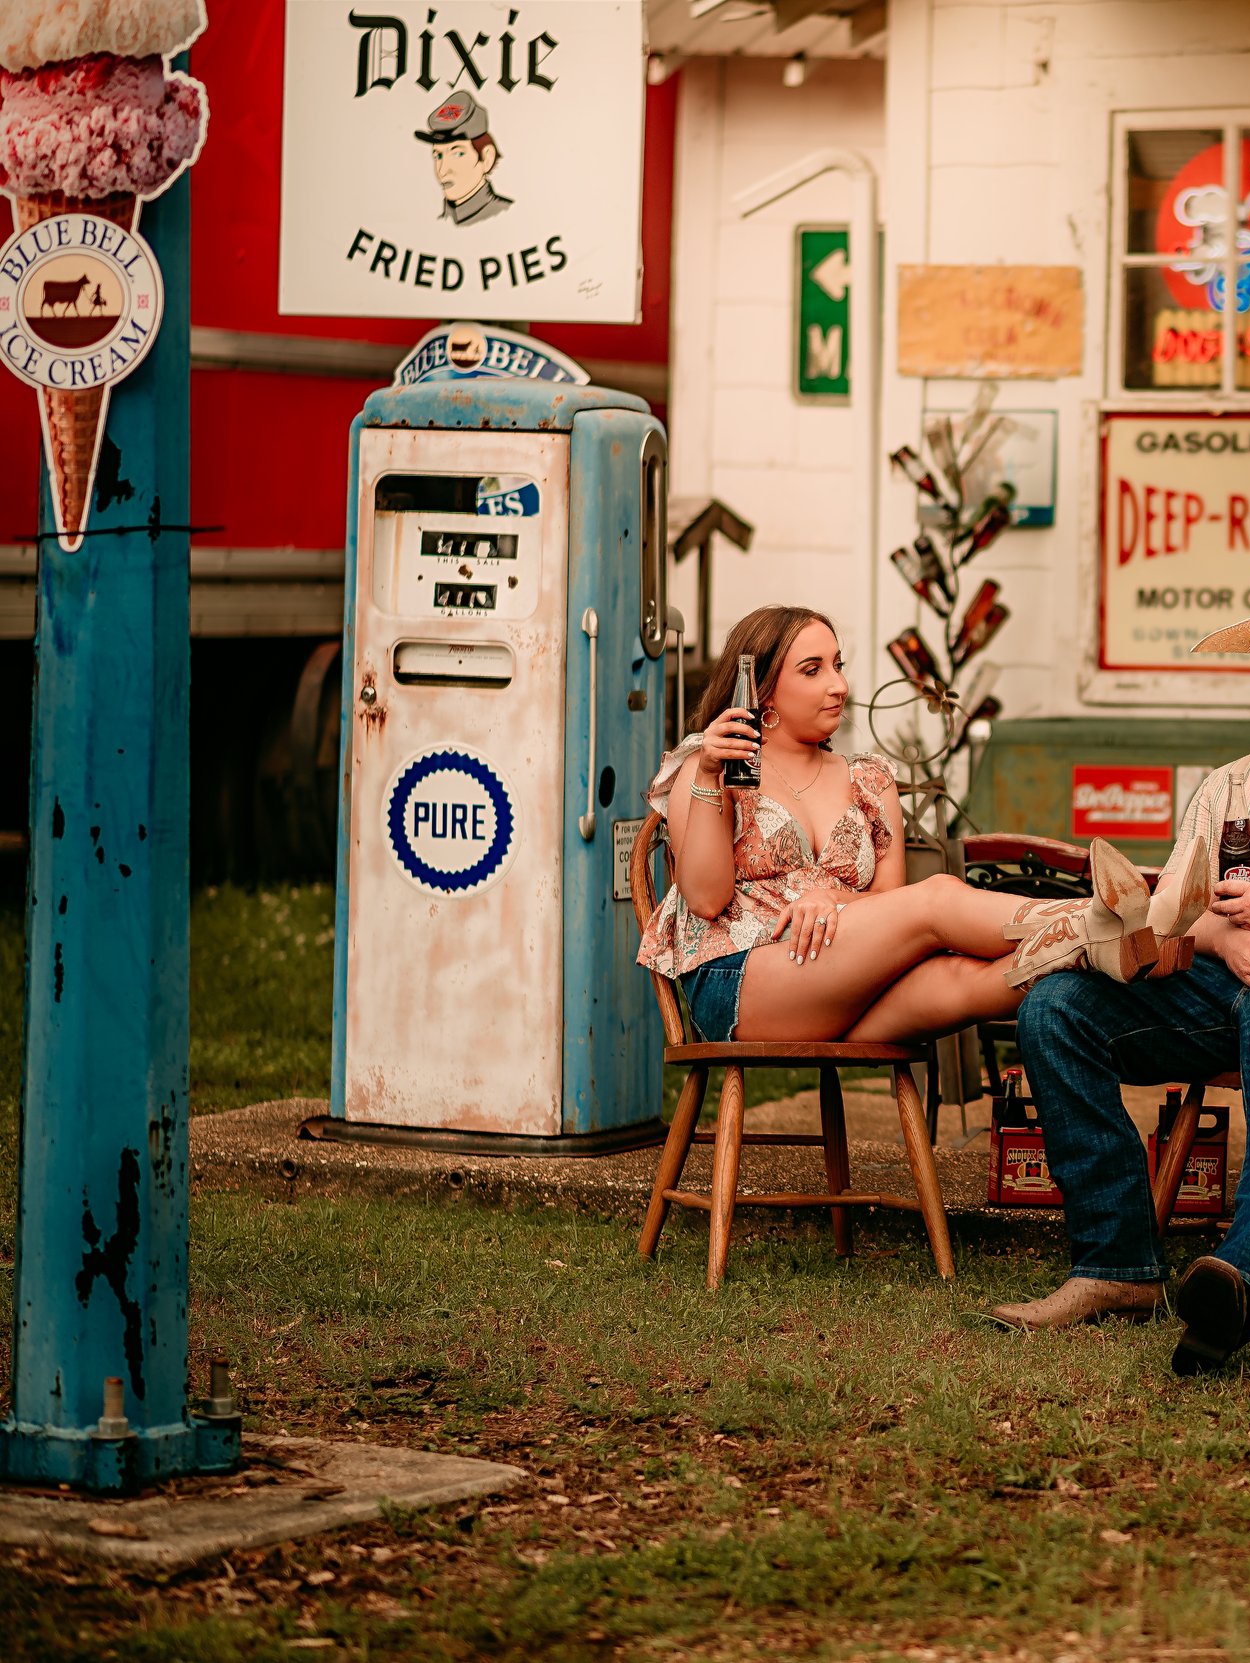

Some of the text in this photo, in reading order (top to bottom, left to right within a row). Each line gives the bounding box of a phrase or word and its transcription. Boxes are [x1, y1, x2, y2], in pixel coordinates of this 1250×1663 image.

[348, 8, 560, 98] Dixie
[1, 218, 143, 285] BLUE BELL
[346, 228, 568, 292] FRIED PIES
[0, 318, 148, 387] ICE CREAM
[1135, 585, 1235, 611] MOTOR
[414, 802, 486, 840] PURE
